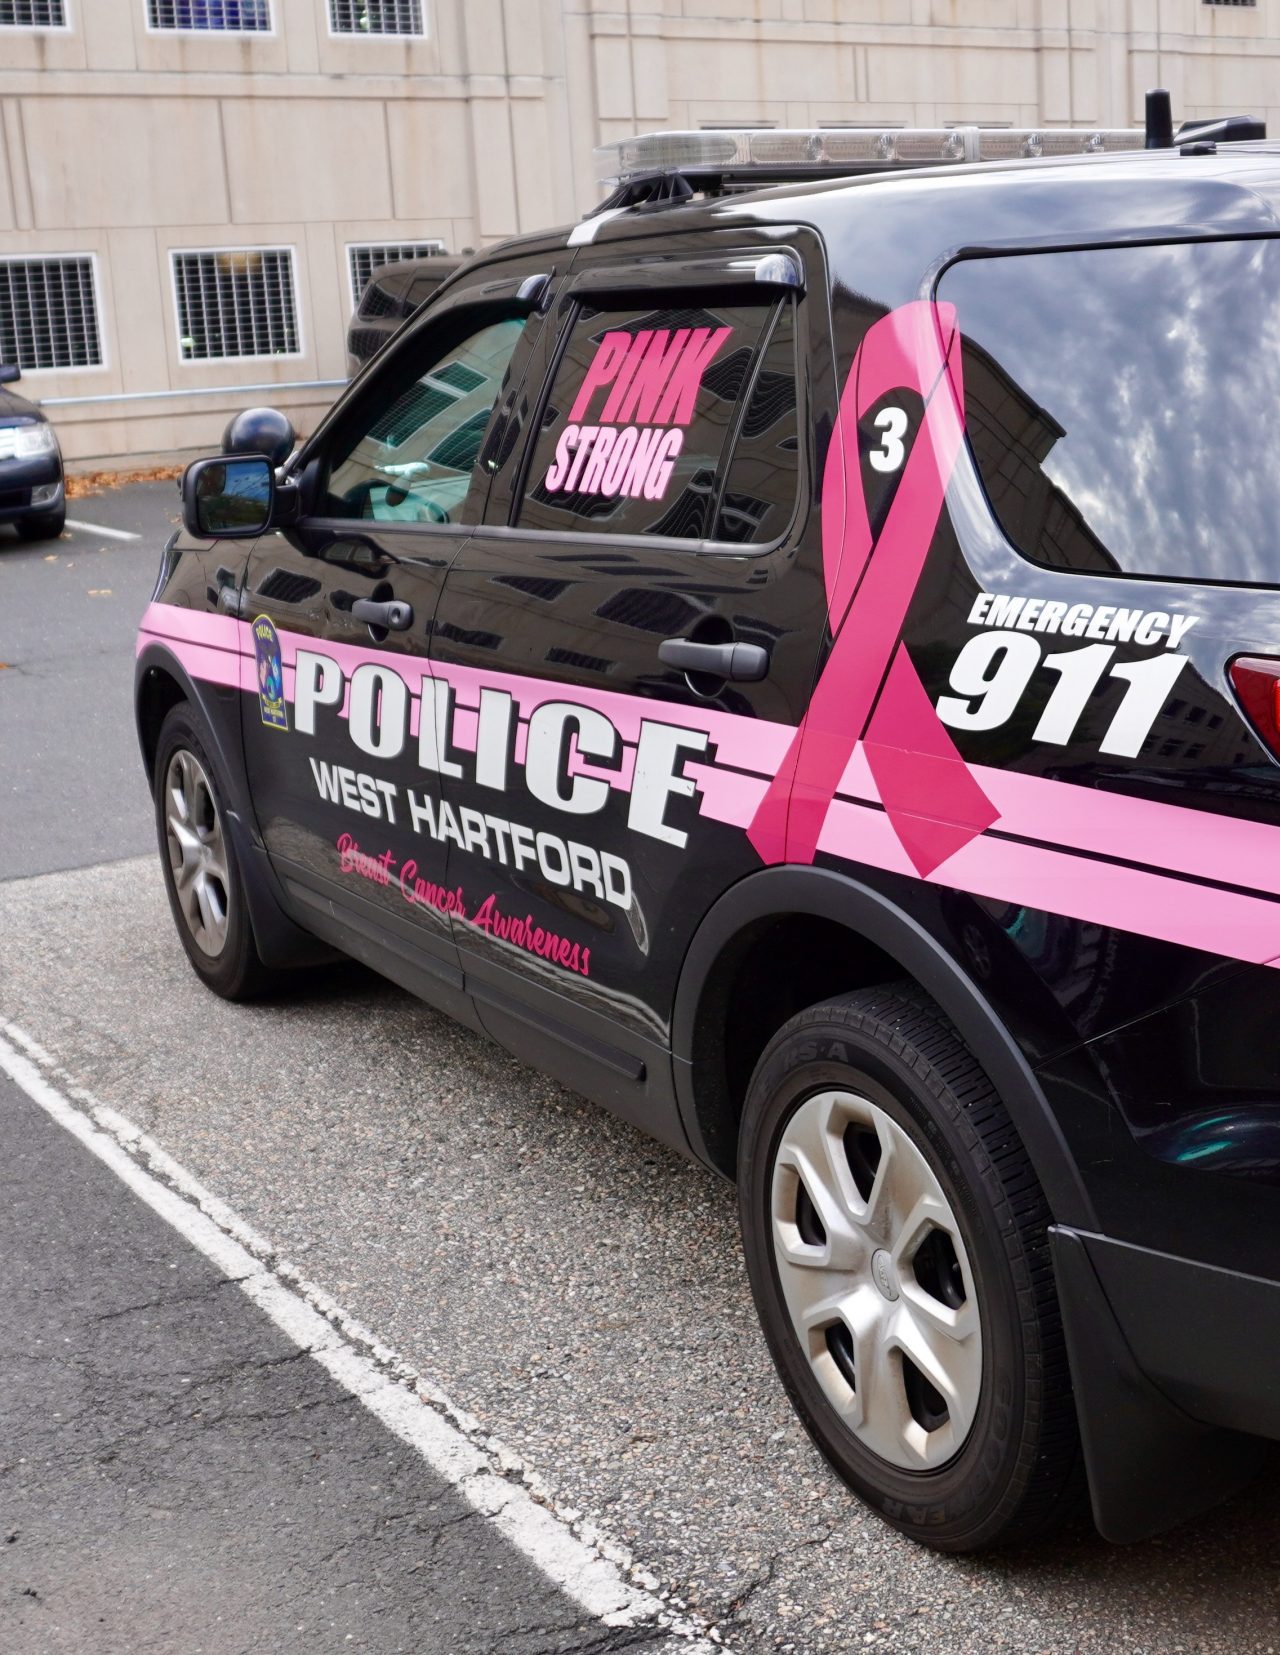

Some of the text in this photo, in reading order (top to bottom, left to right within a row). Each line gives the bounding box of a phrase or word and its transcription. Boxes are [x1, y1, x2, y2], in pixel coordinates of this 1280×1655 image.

[567, 326, 734, 426] PINK
[545, 424, 684, 500] STRONG
[868, 406, 908, 474] 3
[967, 592, 1201, 649] EMERGENCY
[295, 649, 712, 849] POLICE
[936, 631, 1190, 759] 911
[309, 757, 632, 909] WEST HARTFORD
[337, 833, 592, 977] Breast Cancer Awareness
